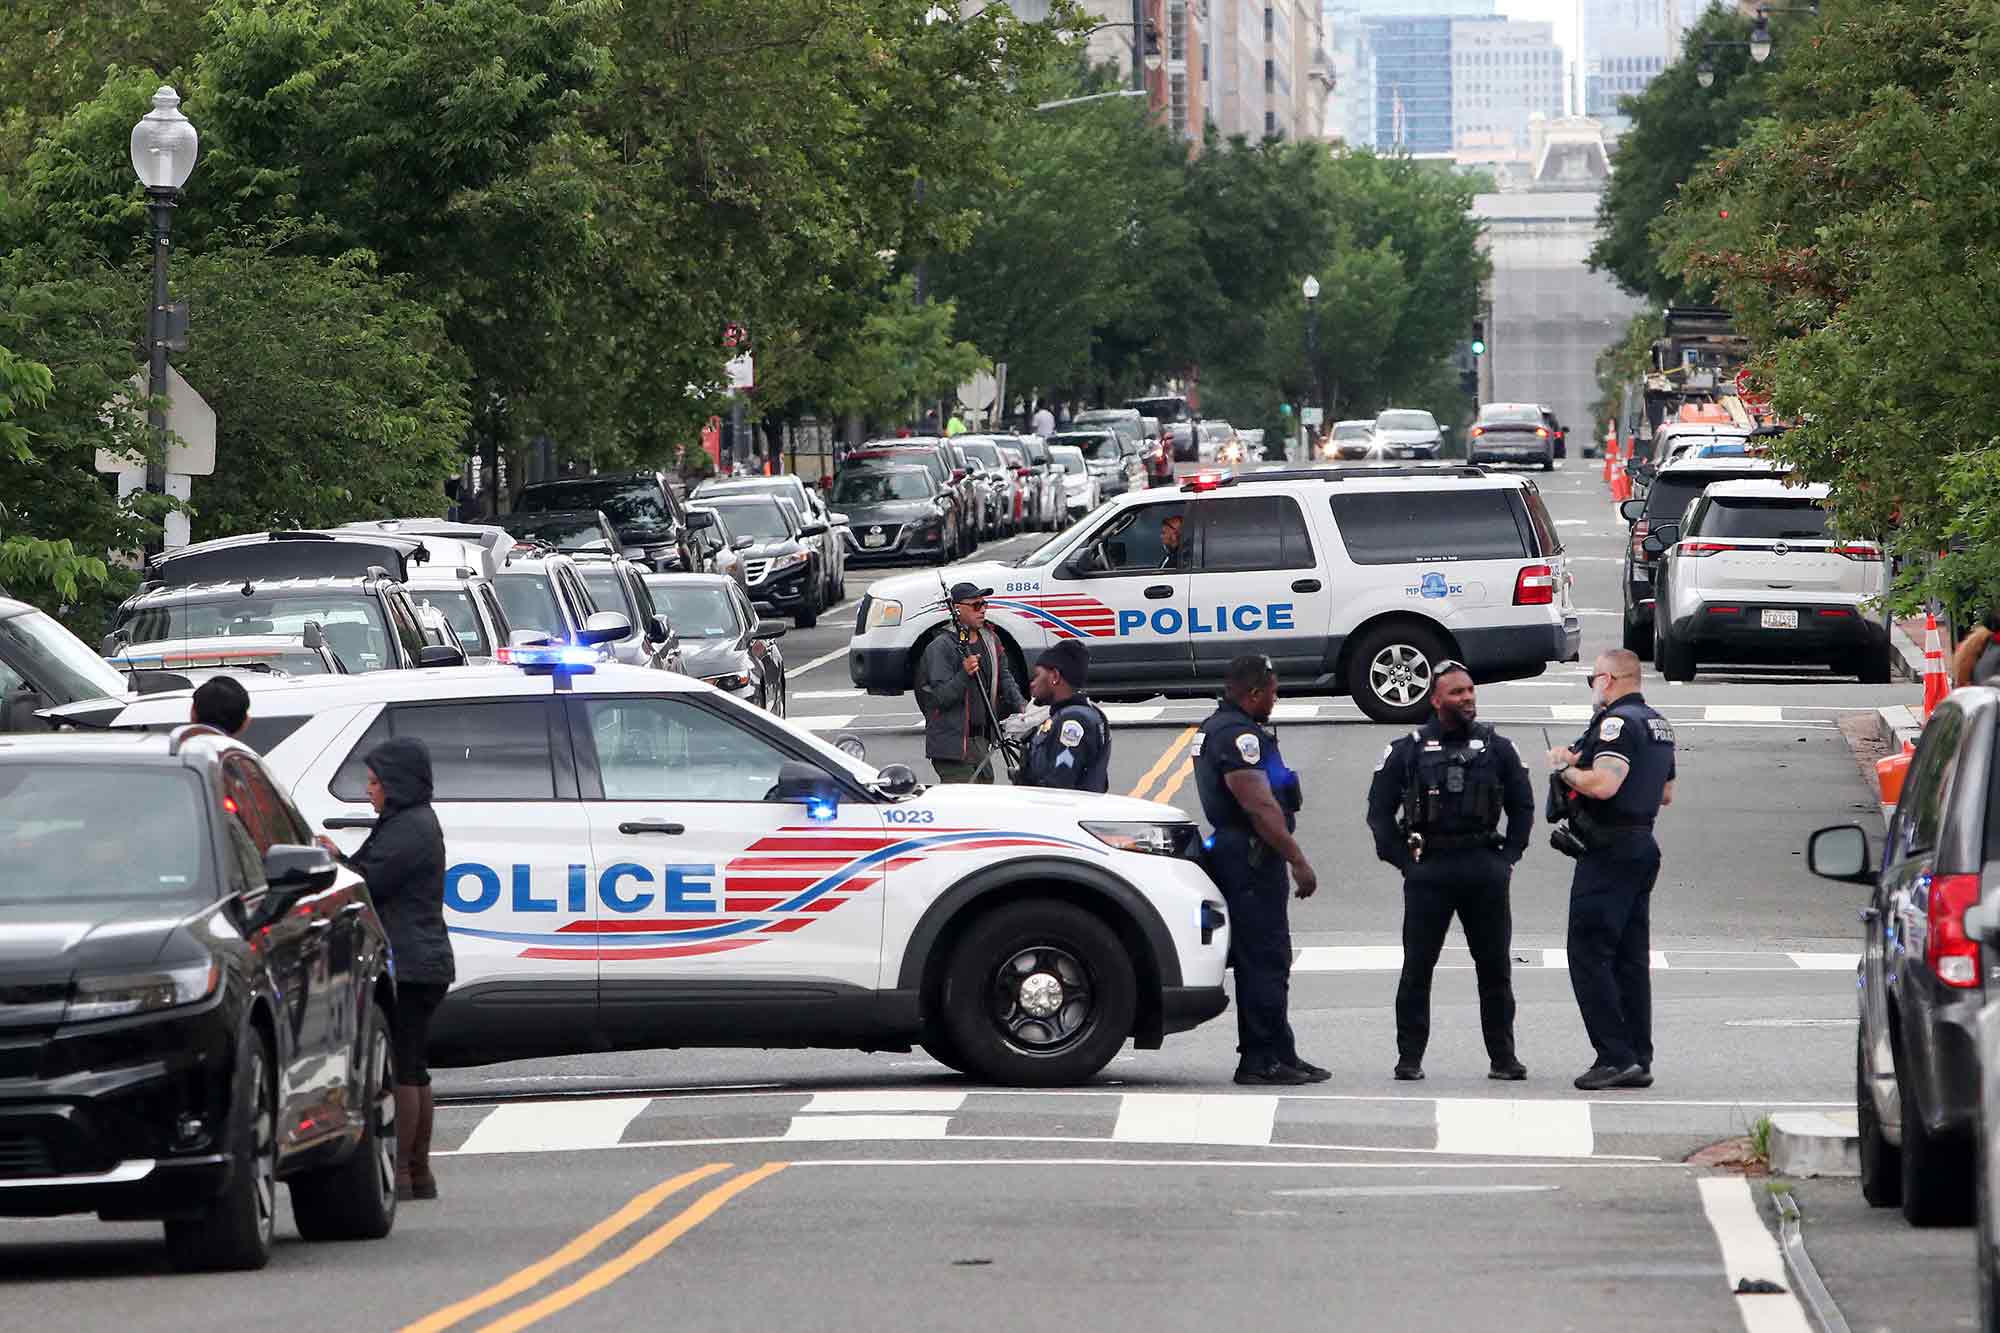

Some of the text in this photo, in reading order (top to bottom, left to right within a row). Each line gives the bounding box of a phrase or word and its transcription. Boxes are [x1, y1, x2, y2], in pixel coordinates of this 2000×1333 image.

[1006, 582, 1040, 592] 8884
[1449, 585, 1463, 594] DC
[1118, 603, 1296, 637] POLICE
[883, 810, 935, 824] 1023
[444, 862, 717, 914] OLICE
